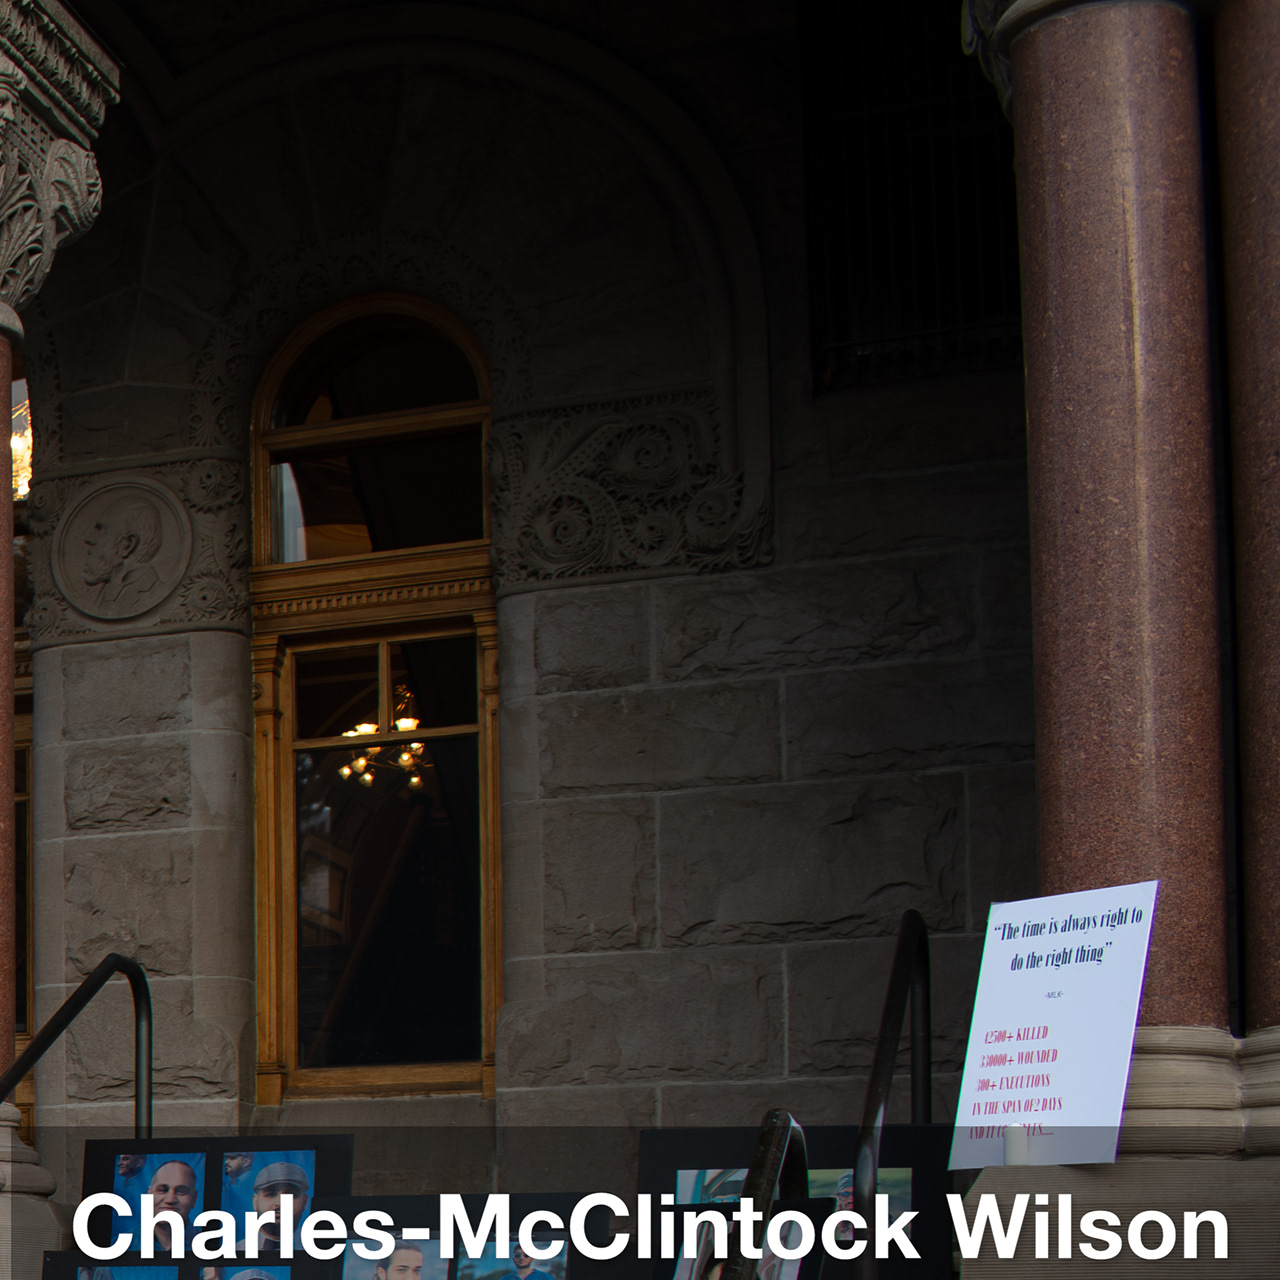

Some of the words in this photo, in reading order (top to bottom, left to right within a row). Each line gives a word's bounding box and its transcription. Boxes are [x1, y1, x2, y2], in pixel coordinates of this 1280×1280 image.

[1022, 919, 1046, 939] time
[1048, 917, 1059, 935] is
[1061, 913, 1099, 935] always
[1100, 909, 1129, 929] right
[1131, 906, 1143, 924] to
[1010, 953, 1024, 972] do
[1025, 951, 1043, 970] the
[1045, 947, 1073, 971] right
[1016, 1025, 1049, 1042] KILLED
[1017, 1048, 1058, 1065] WOUNDED
[976, 1078, 997, 1093] 300+
[999, 1073, 1051, 1091] EXECUTIONS
[972, 1102, 981, 1116] IN
[984, 1100, 1000, 1116] THE
[1002, 1099, 1021, 1114] SPAN
[1041, 1096, 1063, 1112] DAYS
[969, 1125, 985, 1140] AND
